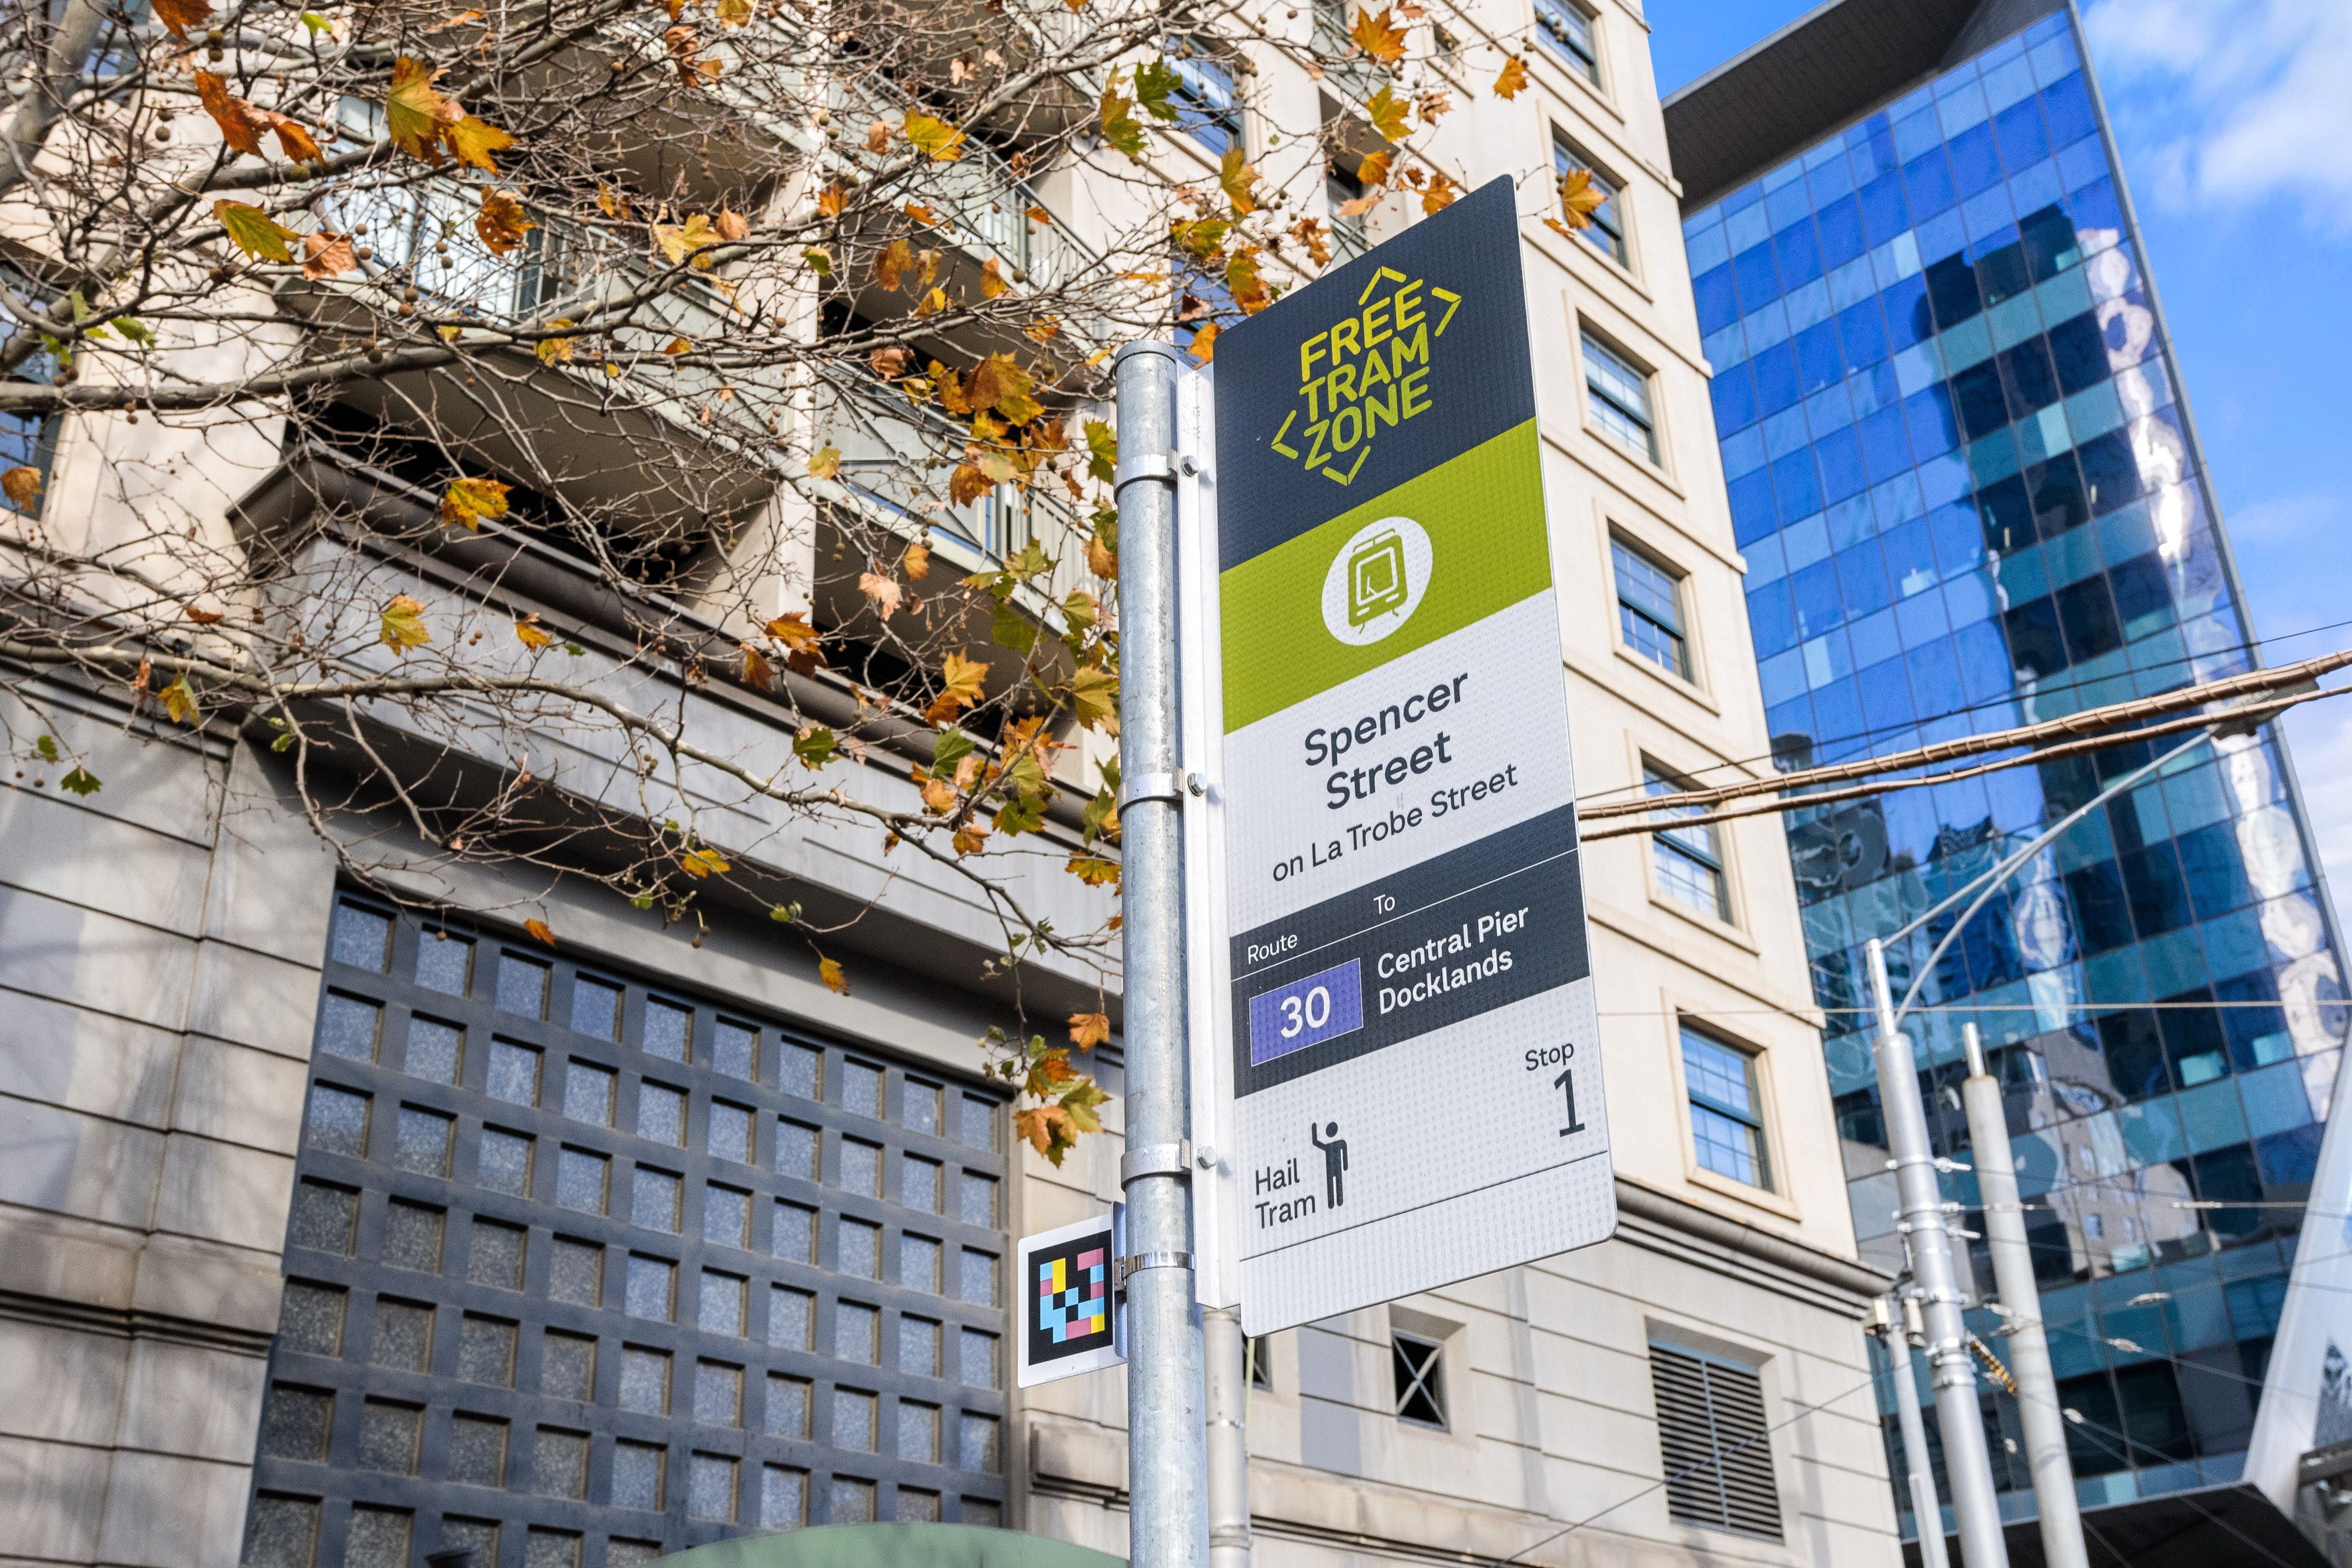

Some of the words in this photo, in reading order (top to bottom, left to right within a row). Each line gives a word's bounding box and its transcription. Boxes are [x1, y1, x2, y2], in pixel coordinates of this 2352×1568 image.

[1301, 279, 1426, 382] FREE
[1299, 322, 1429, 423] TRAM
[1304, 366, 1433, 471] ZONE
[1304, 673, 1469, 767] Spencer
[1325, 731, 1453, 810] Street
[1272, 854, 1304, 882] on
[1311, 840, 1343, 868] La
[1346, 807, 1422, 851] Trobe
[1430, 764, 1518, 818] Street
[1373, 893, 1396, 915] To
[1247, 932, 1298, 965] Route
[1377, 931, 1471, 979] Central
[1478, 906, 1529, 944] Pier
[1279, 986, 1331, 1038] 30
[1378, 947, 1514, 1015] Docklands
[1525, 1041, 1575, 1072] Stop
[1553, 1069, 1585, 1137] 1
[1254, 1158, 1300, 1196] Hail
[1255, 1195, 1315, 1229] Tram
